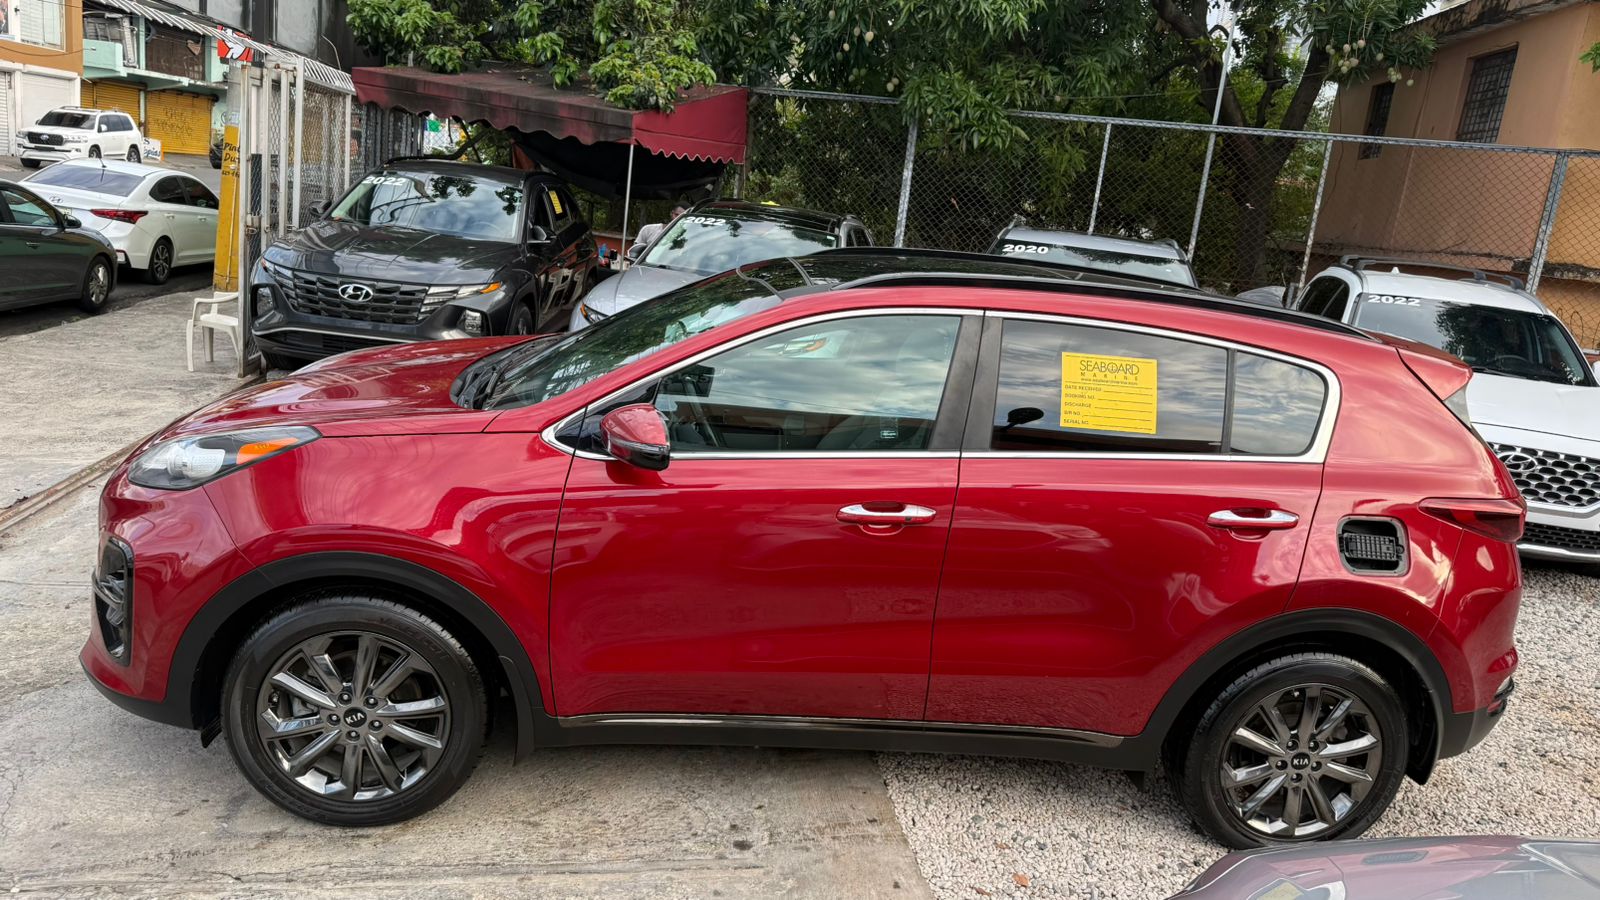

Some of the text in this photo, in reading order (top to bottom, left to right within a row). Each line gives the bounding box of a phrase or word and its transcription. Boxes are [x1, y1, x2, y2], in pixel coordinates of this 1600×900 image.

[361, 176, 407, 186] 2022
[683, 216, 726, 226] 2022
[1002, 244, 1049, 254] 2020
[1367, 294, 1421, 306] 2022
[1079, 360, 1140, 375] SEABOARD
[1080, 371, 1138, 381] MARINE
[345, 712, 365, 724] KIA
[1293, 758, 1309, 766] KIA
